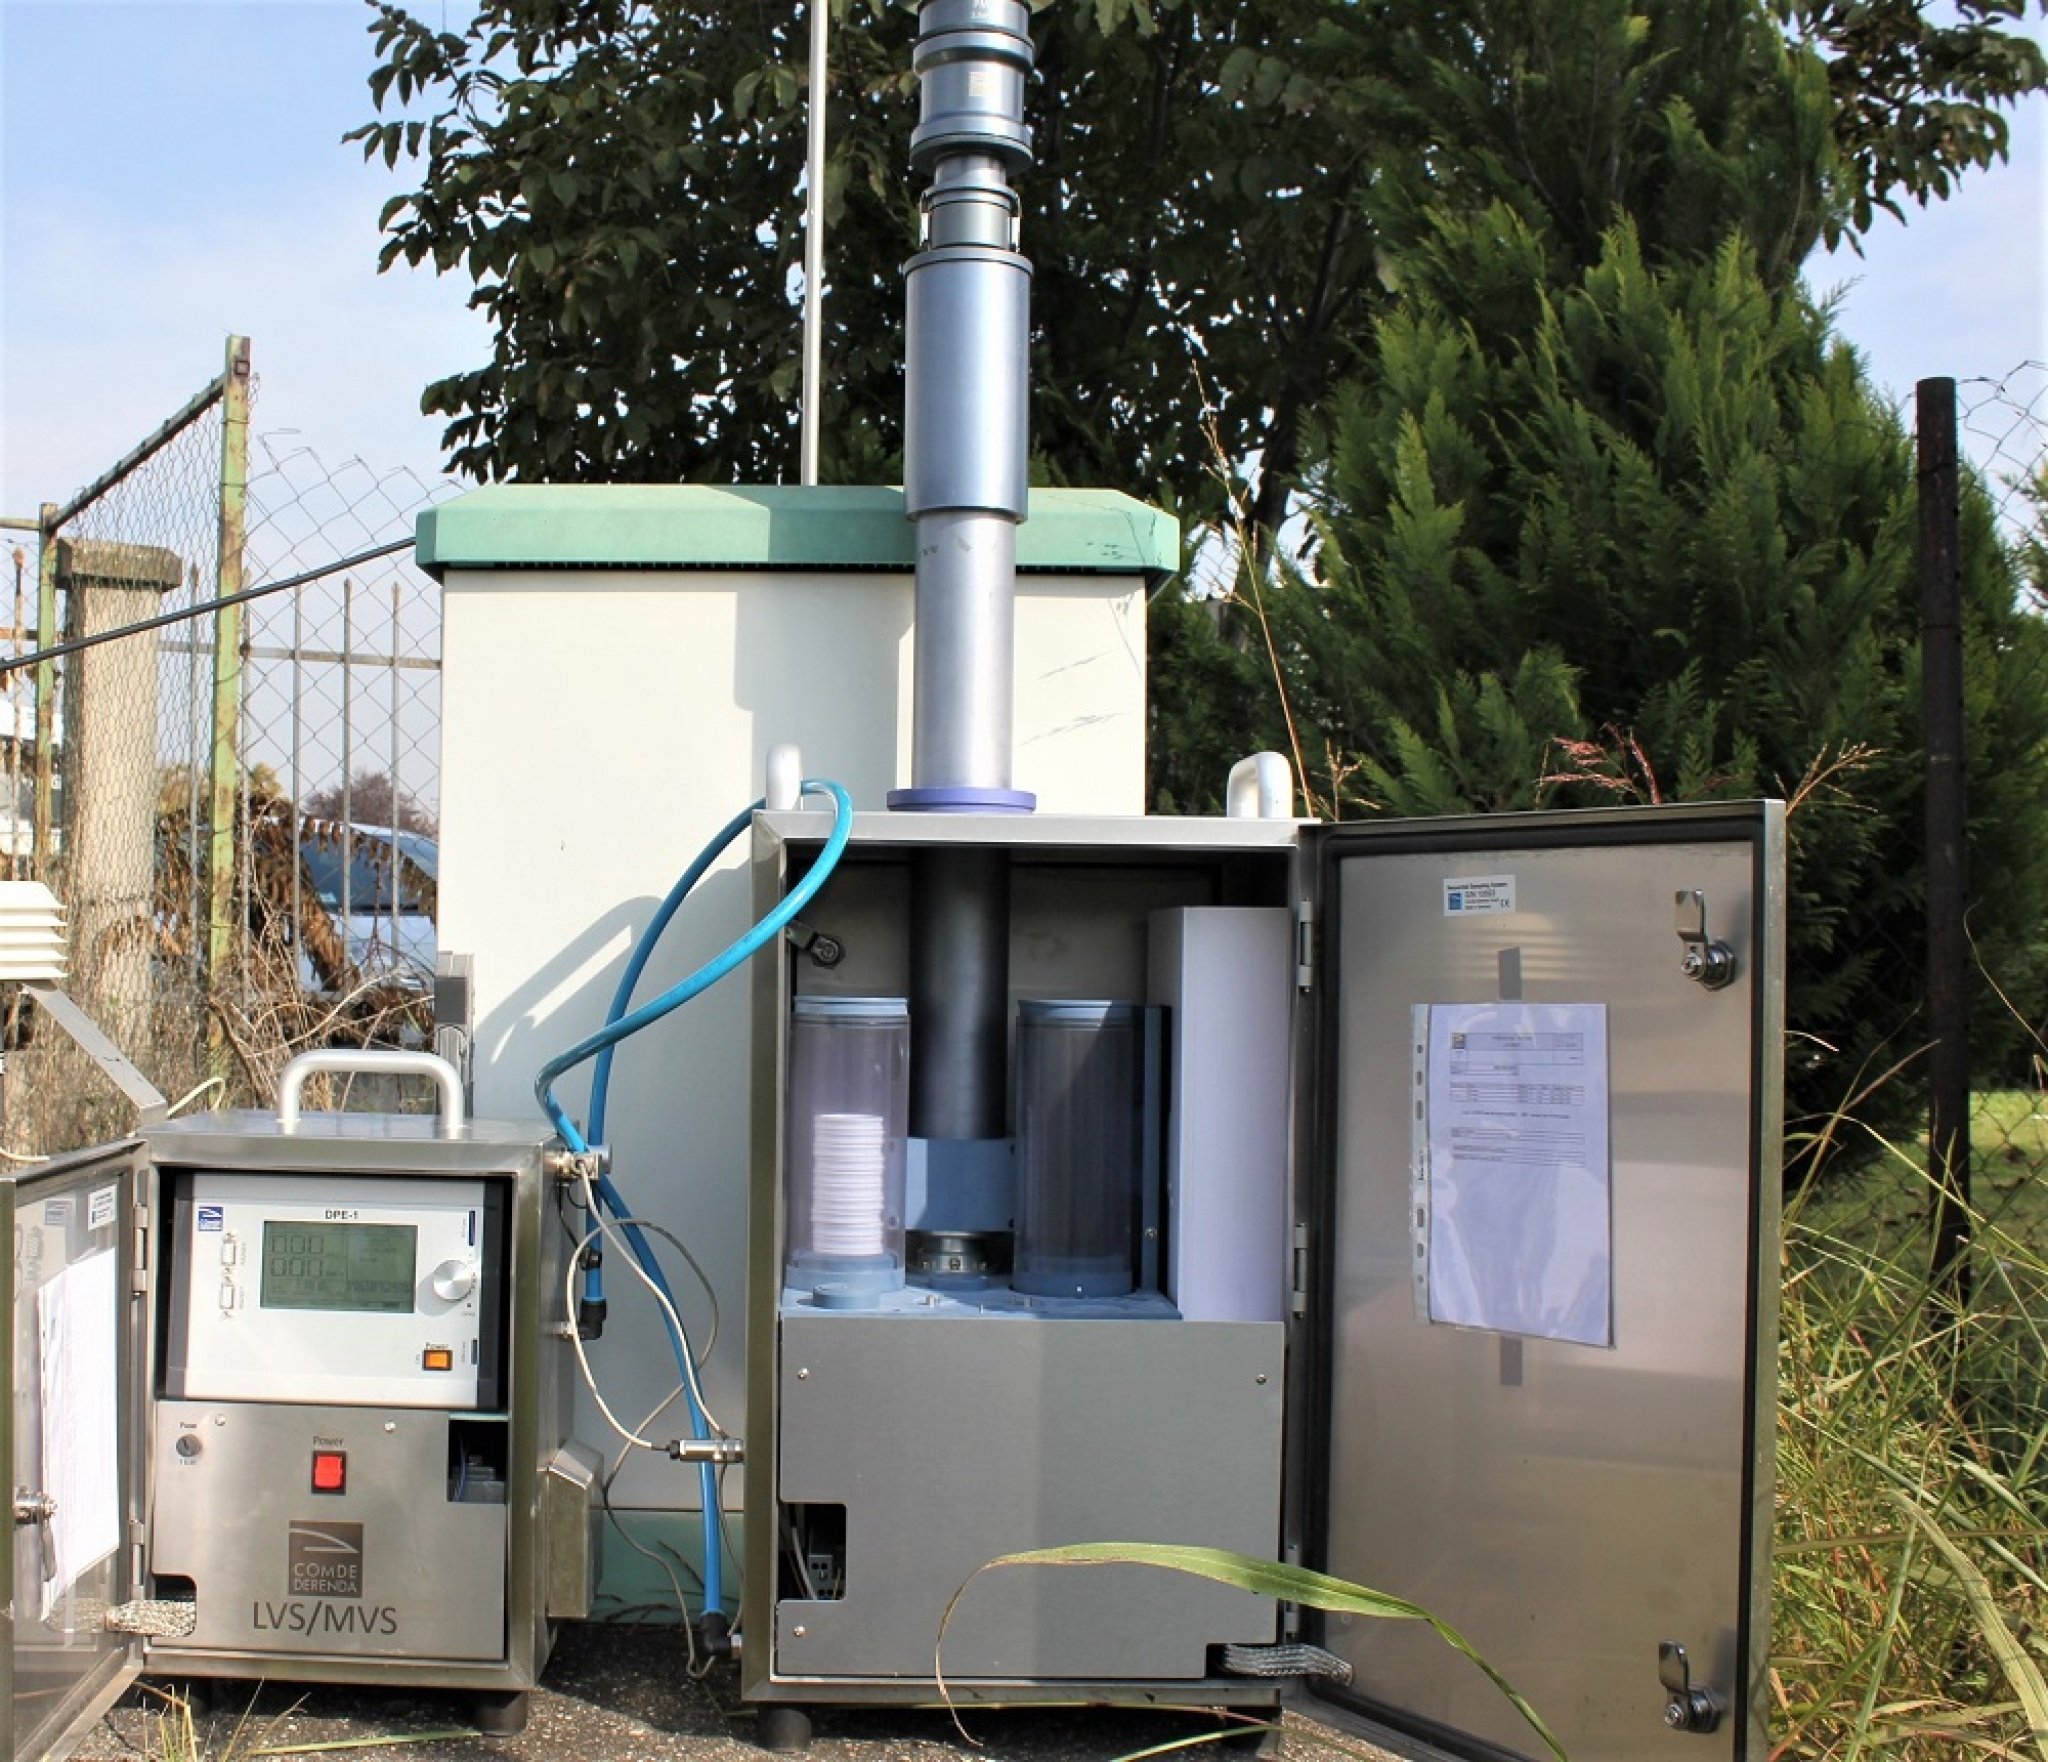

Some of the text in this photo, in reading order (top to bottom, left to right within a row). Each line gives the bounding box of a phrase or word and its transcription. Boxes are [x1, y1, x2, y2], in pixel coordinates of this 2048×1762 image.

[313, 1435, 345, 1447] Power
[294, 1562, 357, 1578] COMDE
[294, 1578, 357, 1592] DERENDA
[253, 1600, 398, 1636] LVS/MVS
